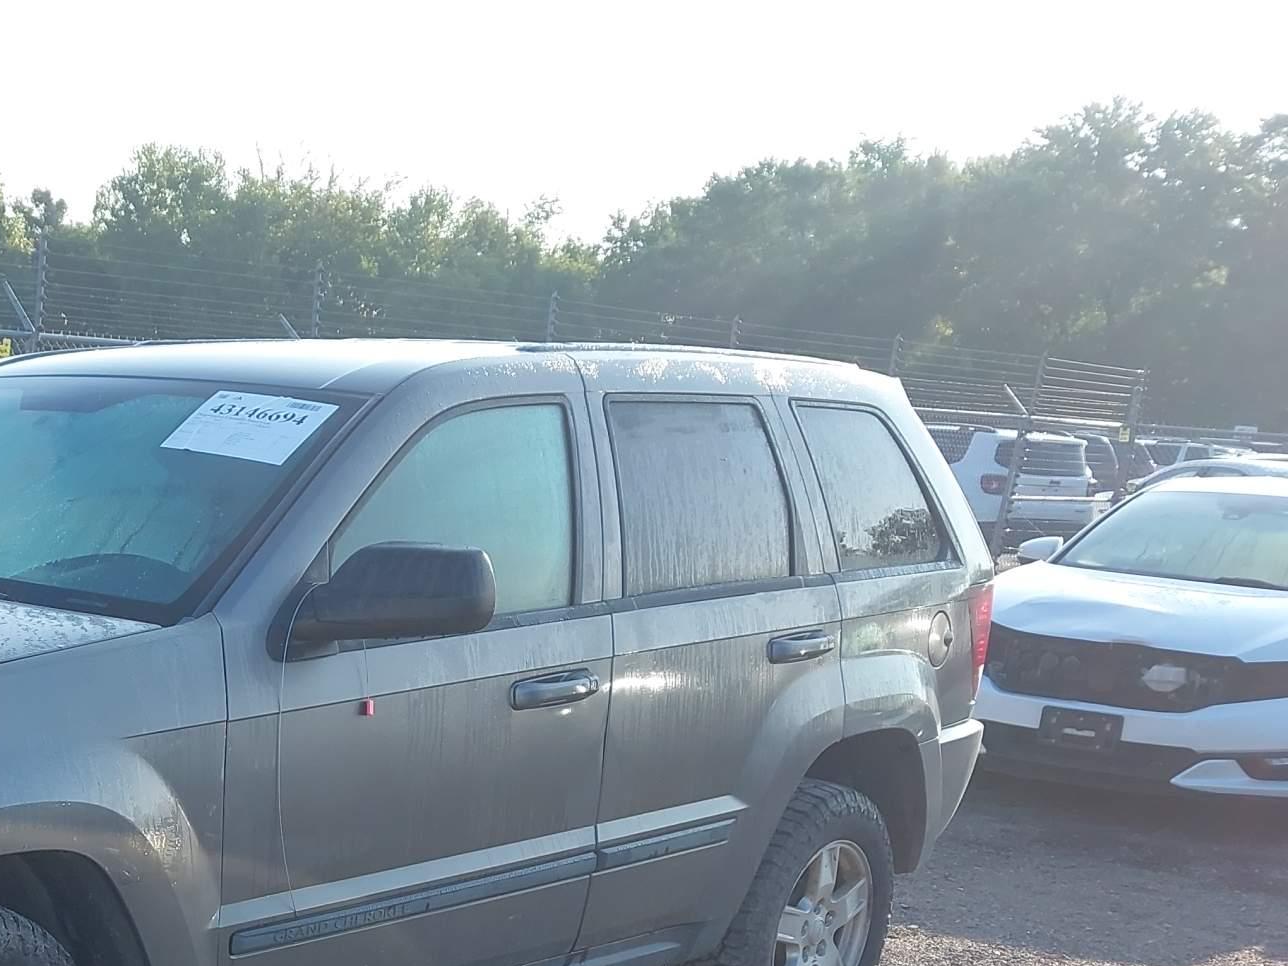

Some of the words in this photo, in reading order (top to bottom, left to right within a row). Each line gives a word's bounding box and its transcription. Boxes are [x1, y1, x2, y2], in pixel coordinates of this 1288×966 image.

[210, 403, 308, 425] 43146694
[273, 922, 330, 943] GRAND
[334, 904, 410, 929] CHEROKEE
